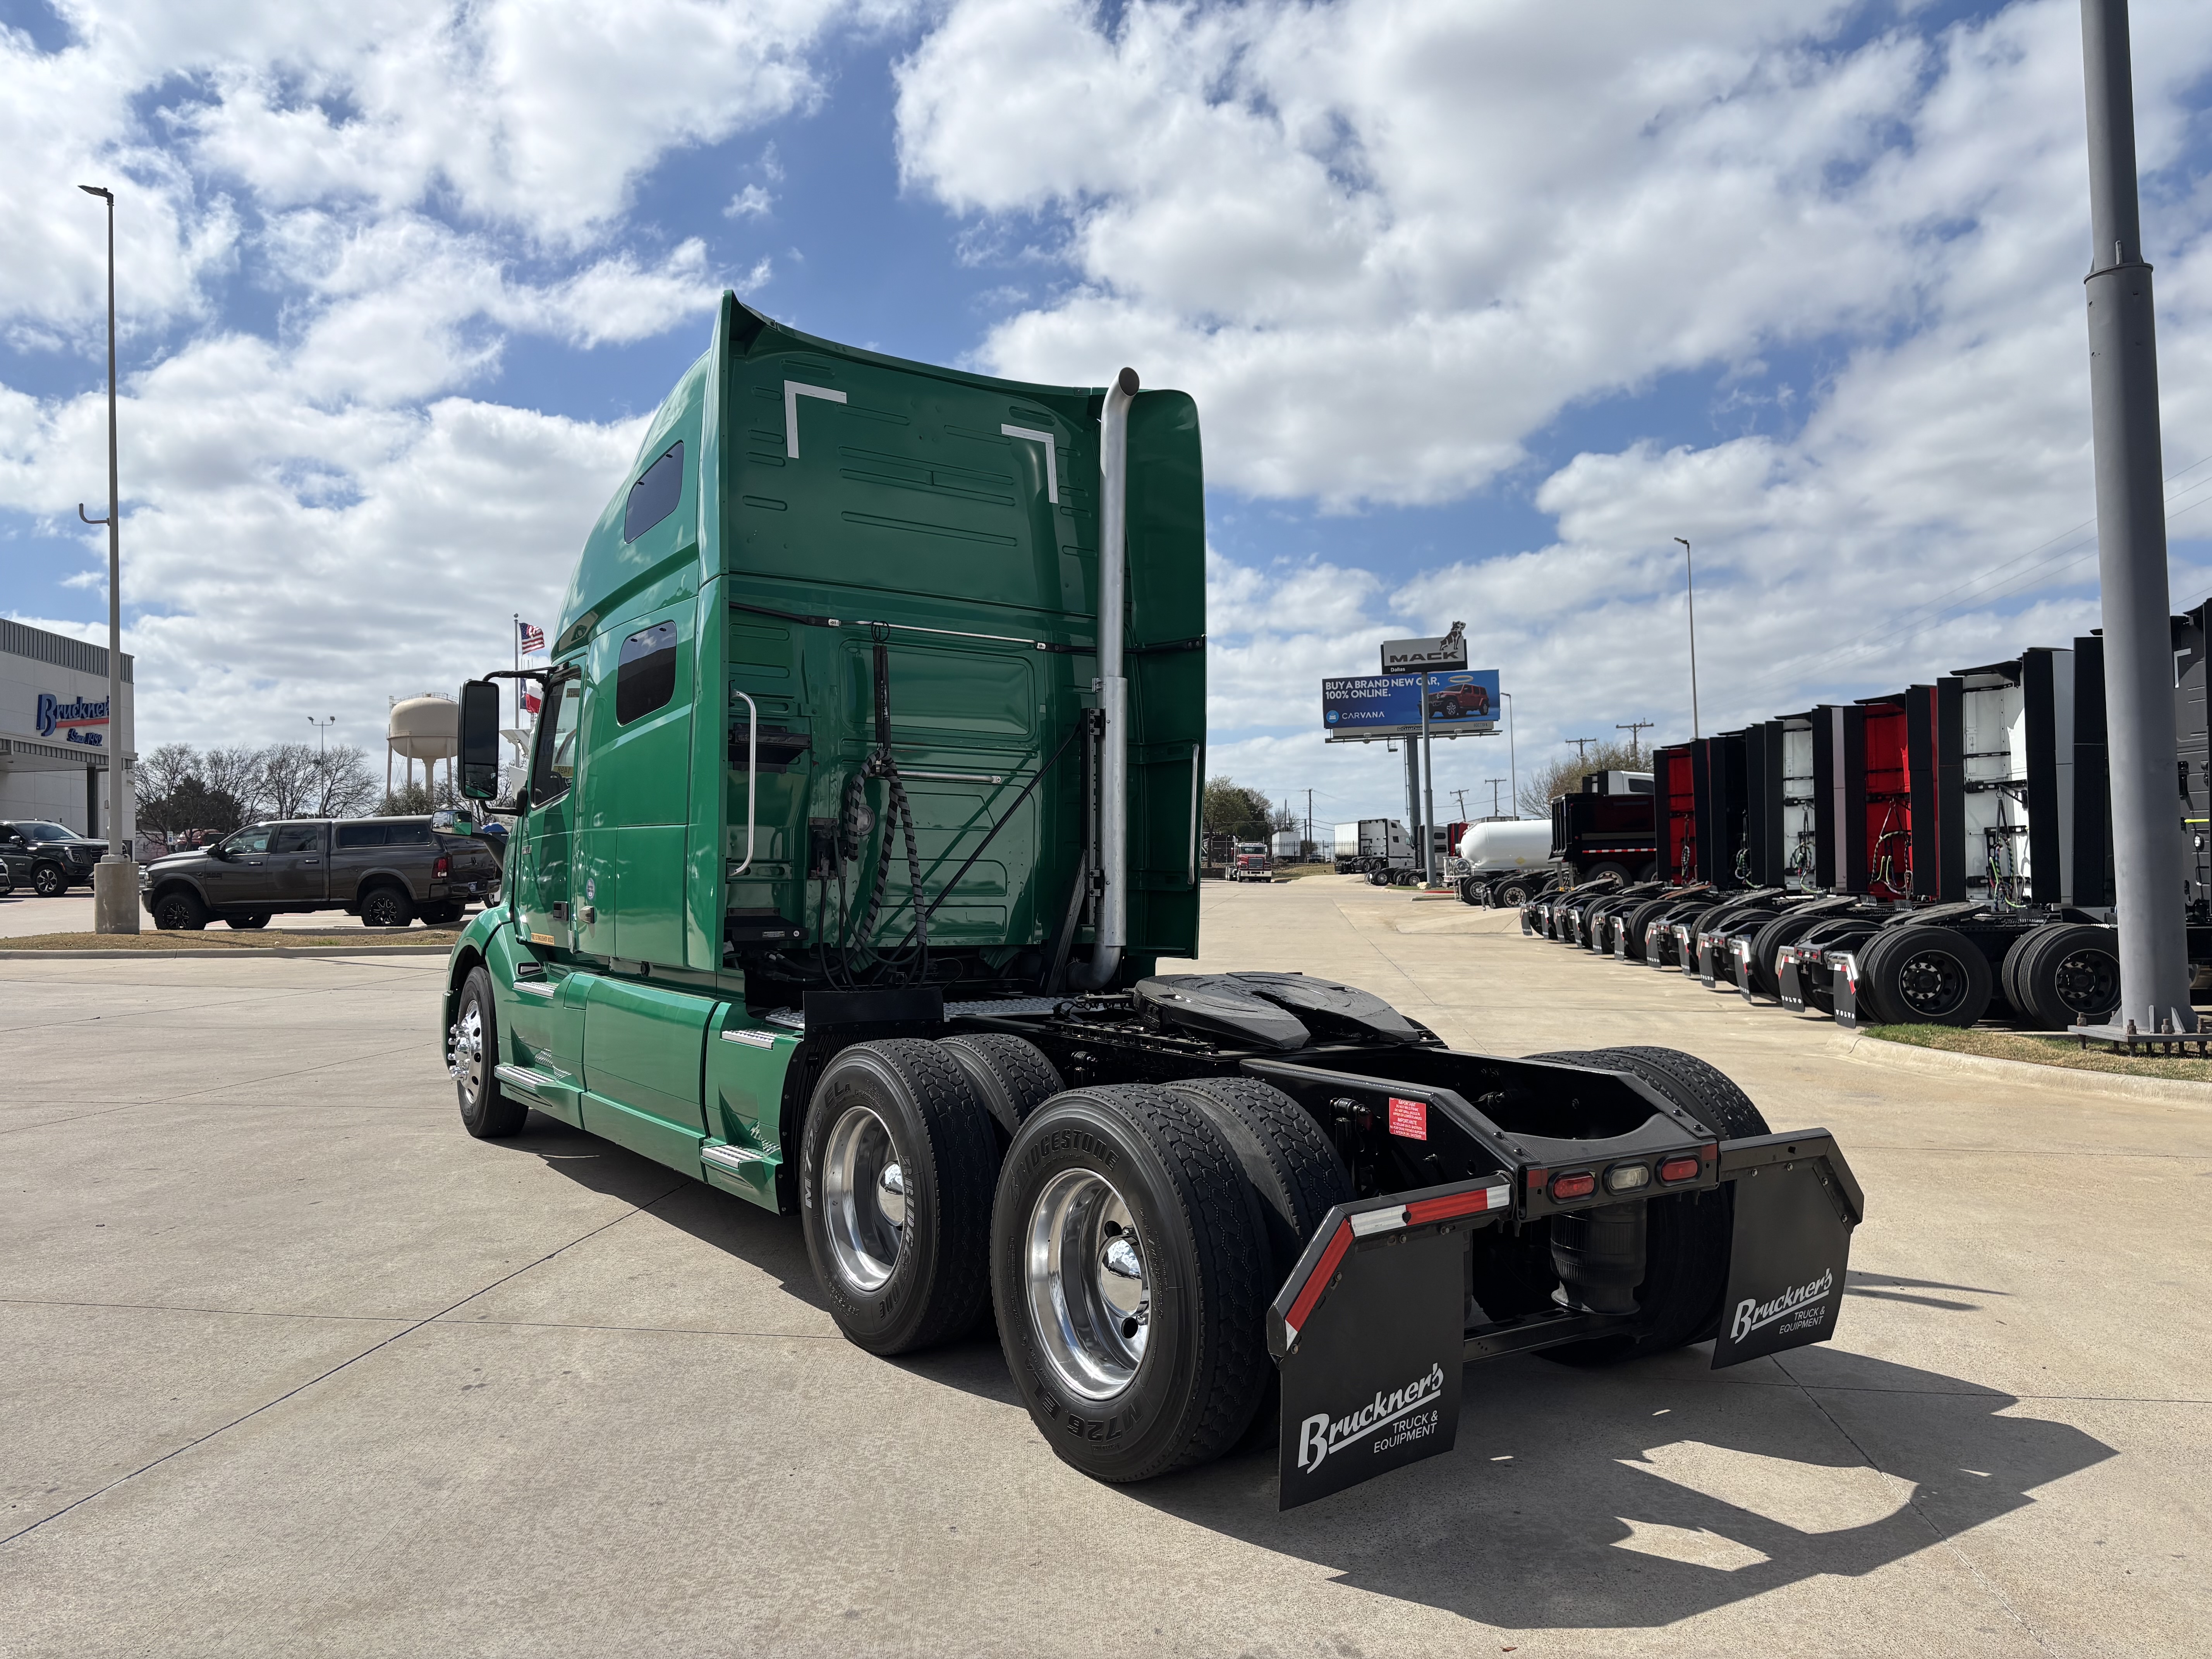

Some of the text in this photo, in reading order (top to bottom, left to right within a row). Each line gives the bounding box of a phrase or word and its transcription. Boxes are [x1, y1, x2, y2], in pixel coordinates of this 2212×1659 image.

[1390, 651, 1459, 663] MACK
[1326, 681, 1345, 690] BUY
[1355, 679, 1389, 689] BRAND
[1391, 678, 1414, 687] NEW
[1416, 677, 1440, 686] CR,
[1326, 689, 1391, 699] 100% ONLINE.
[36, 694, 109, 736] Bruckner
[1342, 711, 1384, 719] CARVANA
[1781, 995, 1802, 1004] VOLVO
[1836, 1009, 1855, 1019] VOLVO
[1008, 1129, 1120, 1211] BRIDGESTONE
[879, 1154, 915, 1321] BRIDGESTONE
[1730, 1267, 1832, 1344] Bruckner's
[1795, 1306, 1825, 1321] TRUCK &
[1779, 1316, 1824, 1334] EQUIPMENT
[1298, 1362, 1444, 1474] Bruckner's
[1393, 1410, 1438, 1434] TRUCK &
[1374, 1422, 1438, 1453] EQUIPMENT
